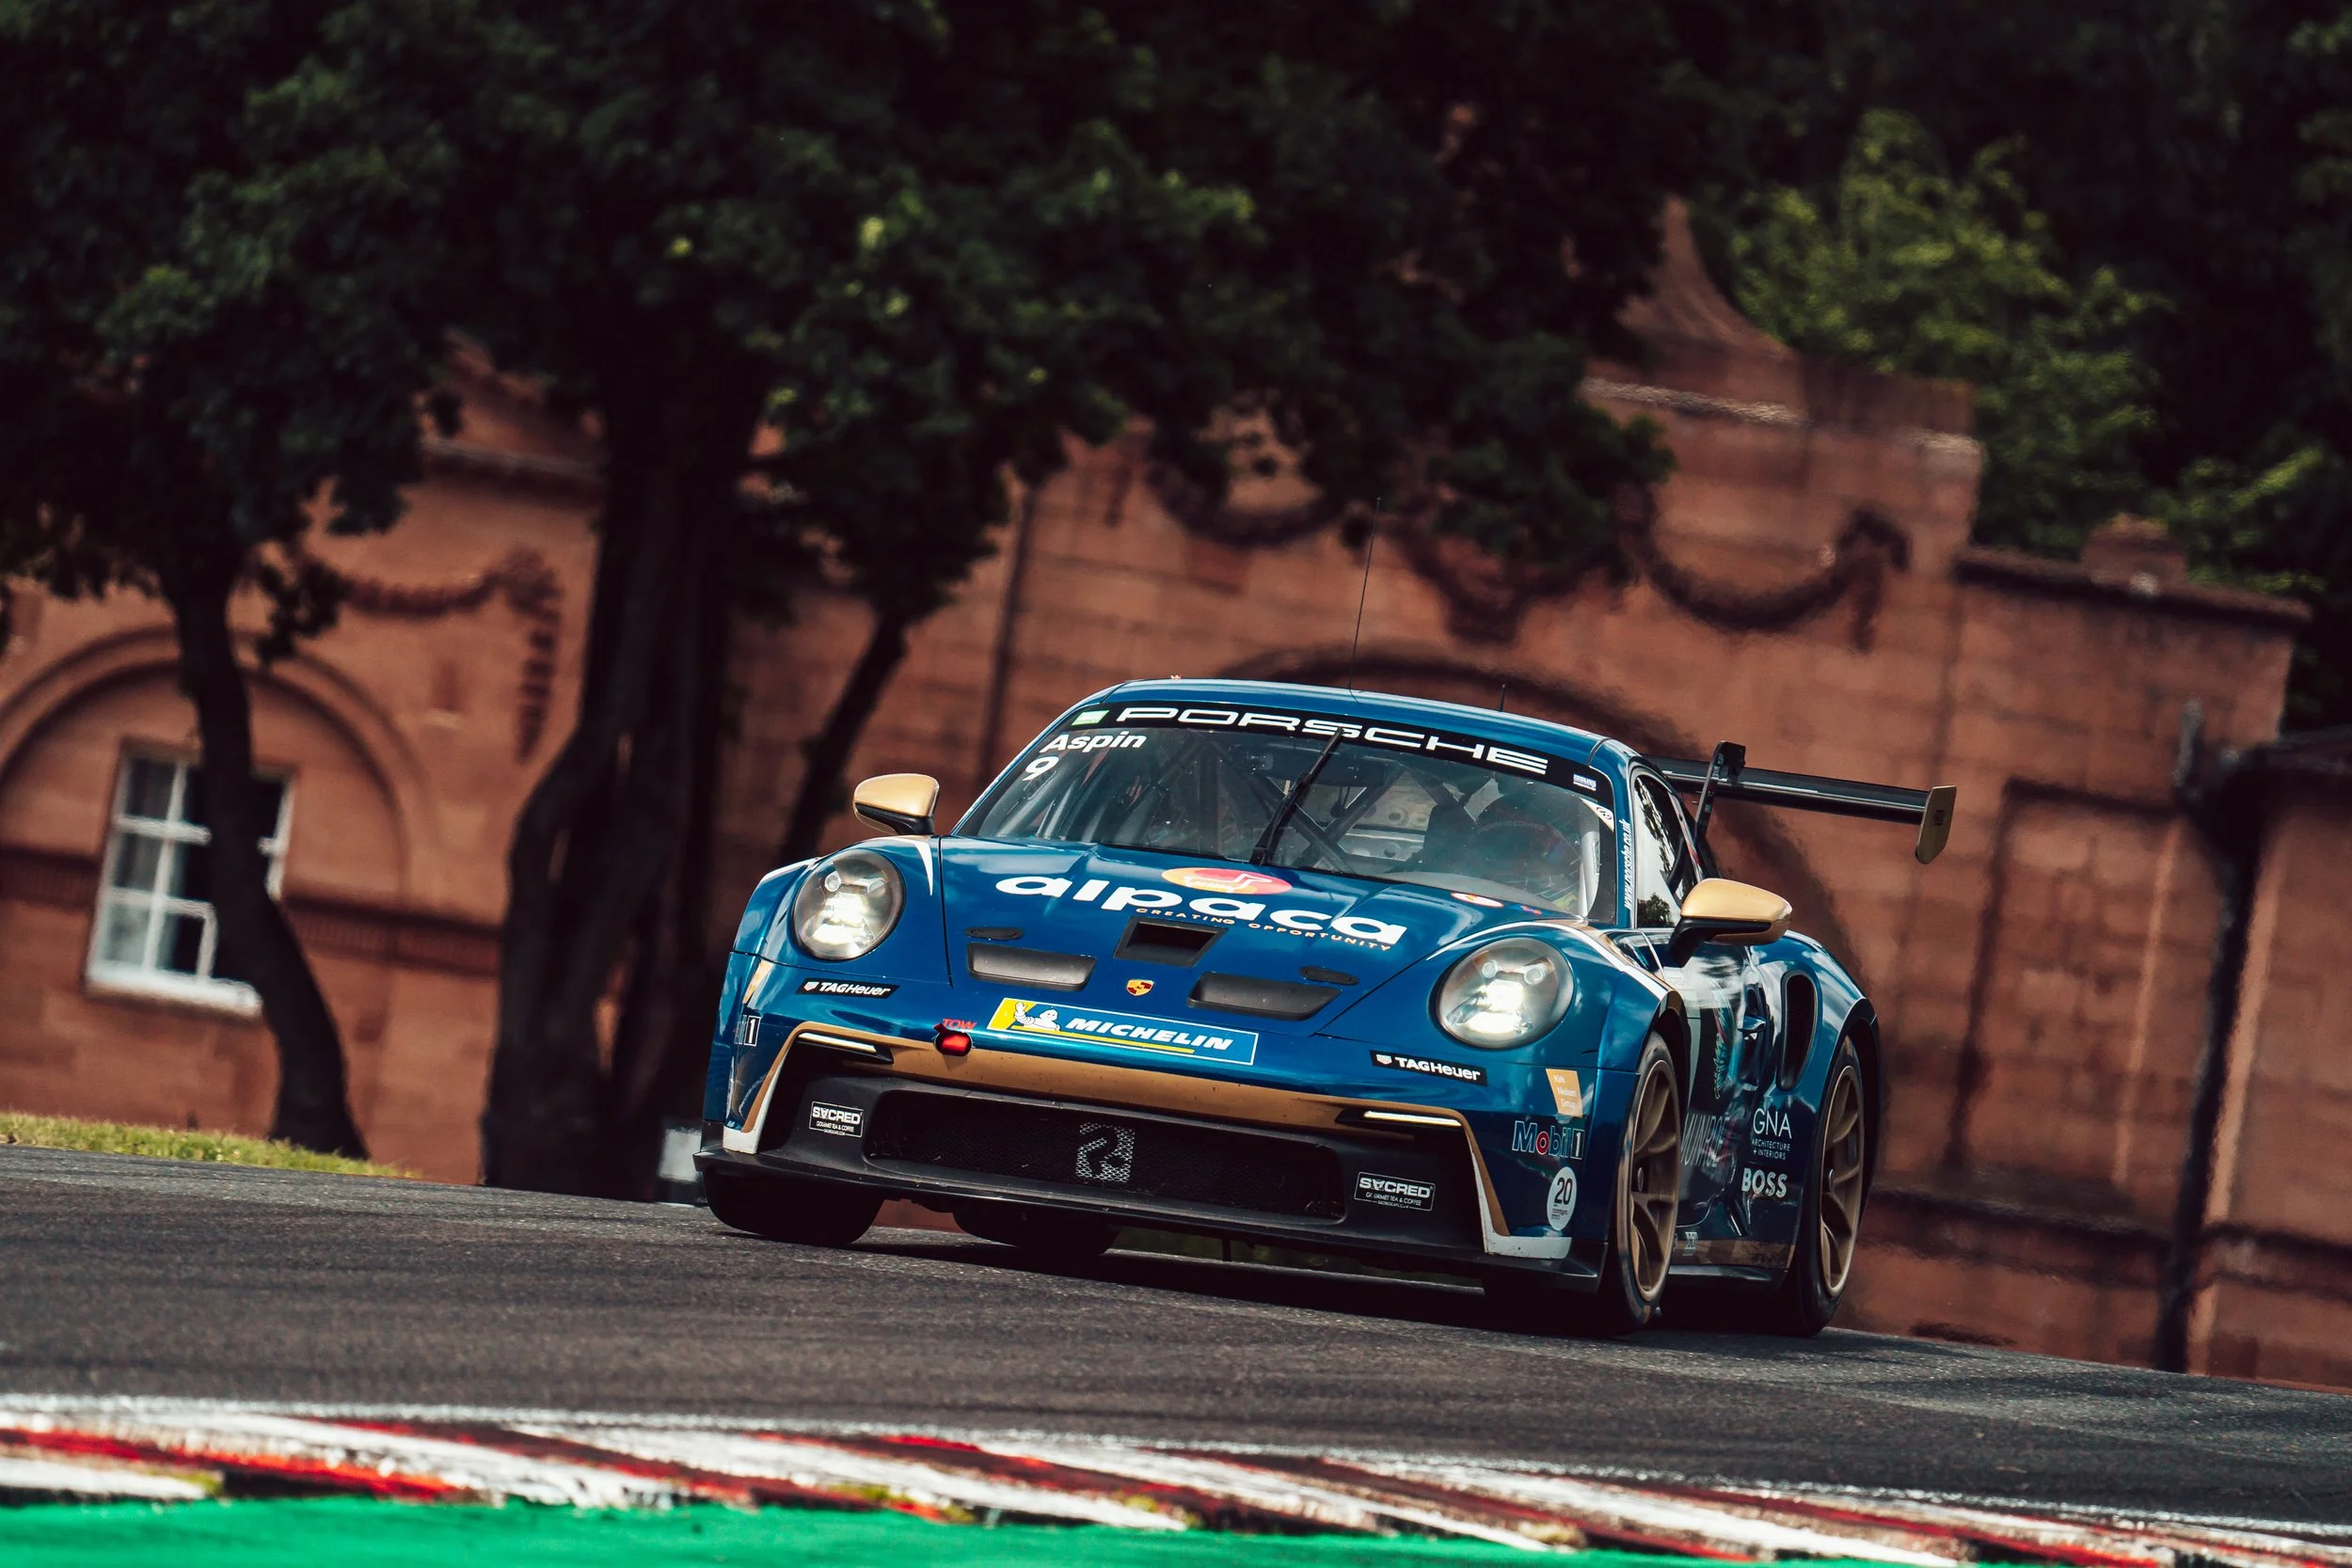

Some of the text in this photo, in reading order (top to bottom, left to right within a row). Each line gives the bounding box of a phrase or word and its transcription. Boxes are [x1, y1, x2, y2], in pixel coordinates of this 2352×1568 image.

[1039, 731, 1147, 753] Aspin
[1116, 706, 1549, 775] PORSCHE
[1022, 755, 1059, 782] 9
[995, 875, 1408, 945] alpaca
[1136, 908, 1391, 951] CREATING OPPORTUNITY
[942, 1018, 977, 1031] TOW
[1065, 1017, 1233, 1051] MICHELIN
[812, 1106, 861, 1125] SACRED
[1753, 1108, 1792, 1139] GNA
[1512, 1120, 1571, 1158] Mobil
[1751, 1139, 1791, 1152] ARCHITECTURE
[1757, 1148, 1786, 1161] INTERIORS
[1359, 1177, 1430, 1198] SACRED
[1554, 1177, 1573, 1205] 20
[1741, 1167, 1788, 1198] BOSS
